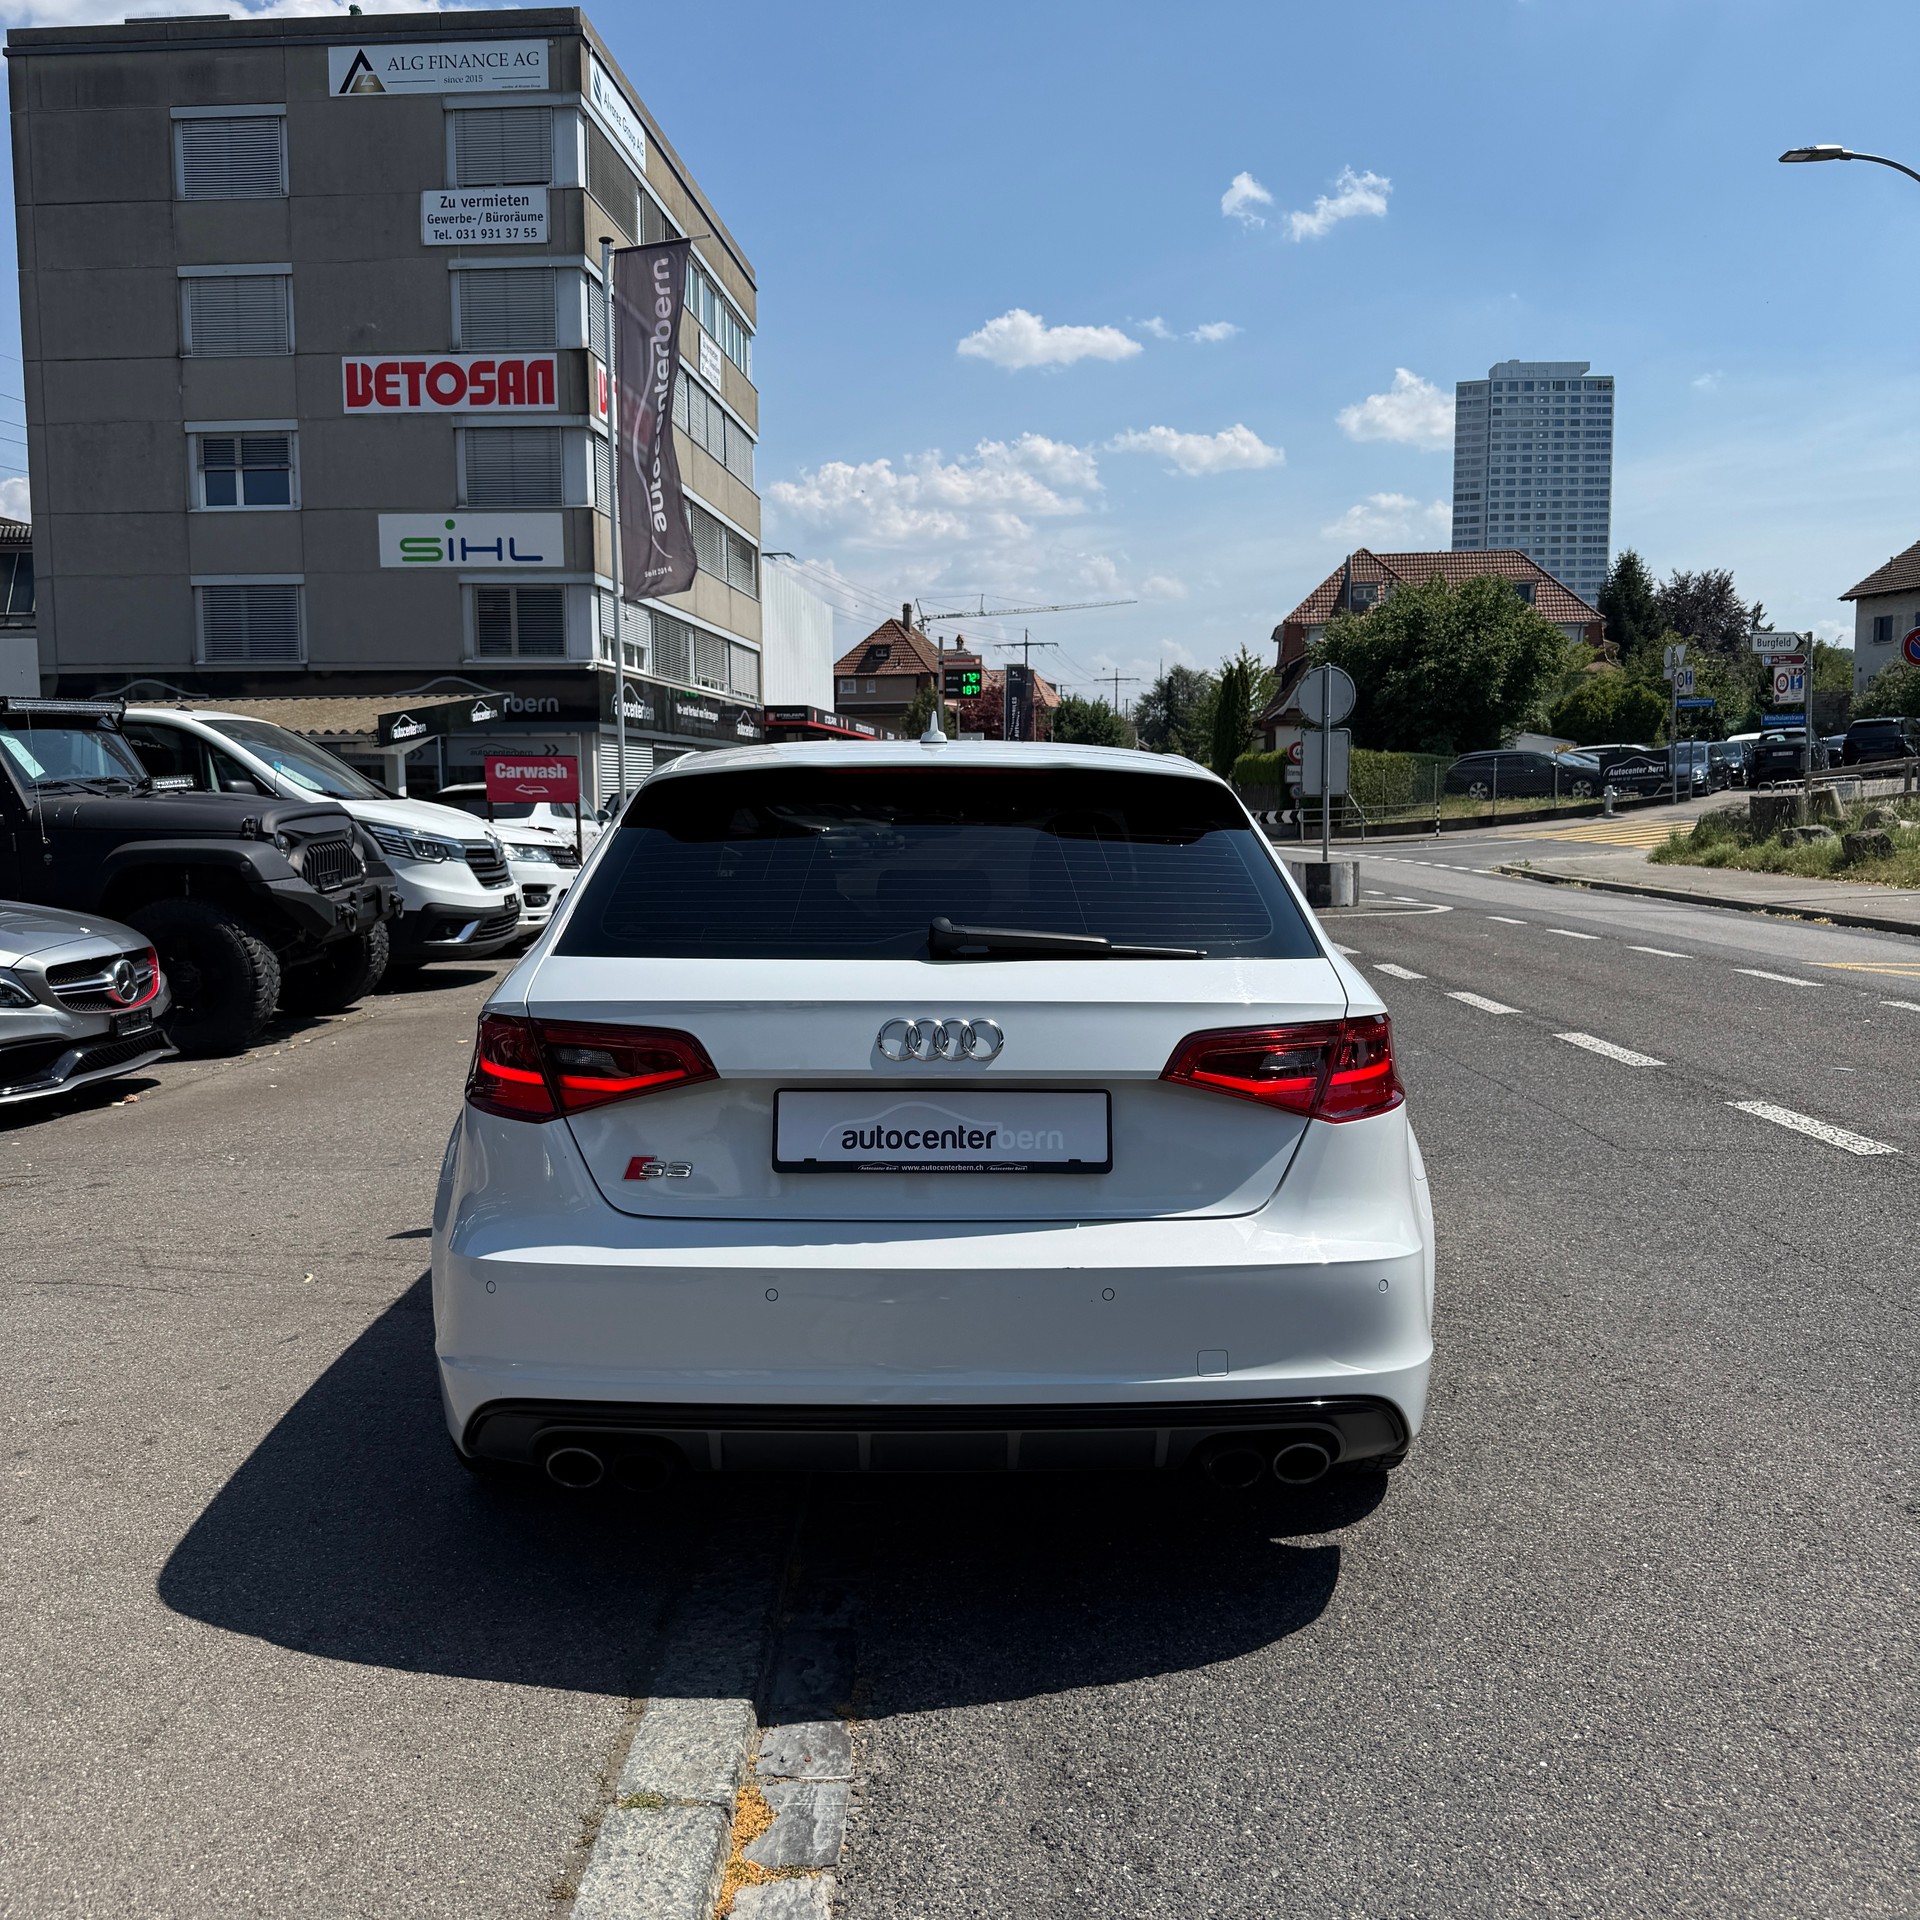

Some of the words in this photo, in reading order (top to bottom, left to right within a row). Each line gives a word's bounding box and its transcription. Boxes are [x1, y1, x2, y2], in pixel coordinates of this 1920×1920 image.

[387, 55, 424, 71] ALG
[428, 52, 509, 70] FINANCE
[513, 51, 540, 67] AG
[443, 75, 464, 84] since
[465, 74, 484, 83] 2015
[622, 117, 636, 150] Group
[440, 195, 456, 208] Zu
[460, 193, 530, 208] vermieten
[485, 211, 544, 223] Büroräume
[433, 229, 452, 240] Tel.
[456, 229, 476, 239] 031
[481, 228, 501, 239] 931
[505, 227, 519, 238] 37
[523, 227, 538, 238] 55
[345, 359, 554, 407] BETOSAN
[1756, 638, 1792, 649] Burgfeld
[494, 762, 568, 779] Carwash
[1608, 765, 1647, 777] Autocenter
[1647, 764, 1664, 773] Bern
[841, 1124, 1064, 1150] autocenterbern
[639, 1160, 692, 1178] S3
[901, 1163, 984, 1172] www.autocenterbern.ch
